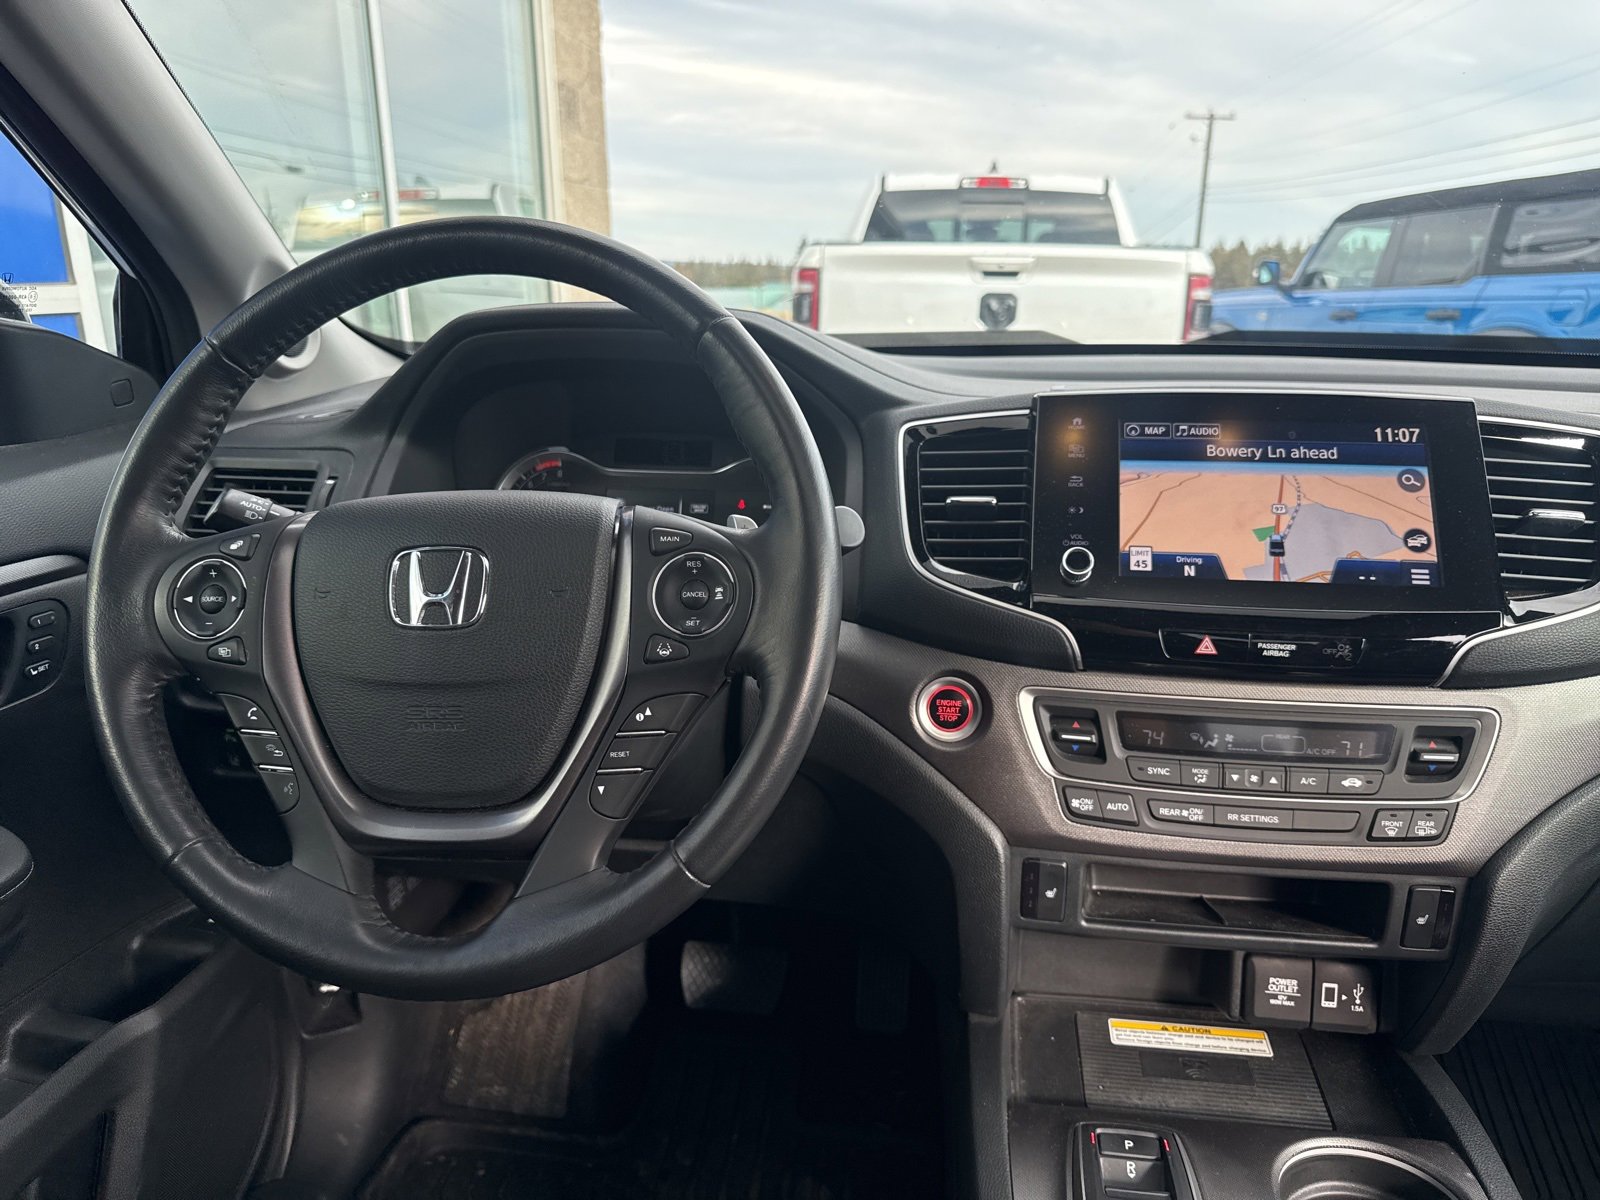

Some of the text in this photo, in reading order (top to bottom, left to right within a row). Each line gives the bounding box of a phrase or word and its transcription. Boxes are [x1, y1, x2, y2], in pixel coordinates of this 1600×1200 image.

[1145, 427, 1166, 435] MAP
[1189, 427, 1219, 436] AUDIO
[1374, 427, 1420, 443] 11:07
[1206, 444, 1338, 460] Bowery Ln ahead
[240, 500, 263, 511] AUTO
[1274, 505, 1284, 513] 97
[686, 560, 702, 568] RES
[1133, 559, 1148, 569] 45
[1176, 556, 1203, 565] Driving
[1183, 565, 1196, 577] N
[1257, 642, 1297, 651] PASSENGER
[1262, 649, 1290, 658] AIRBAG
[936, 699, 963, 707] ENGINE
[939, 714, 959, 722] STOP
[1142, 729, 1165, 746] 74
[1147, 766, 1171, 776] SYNC
[1300, 776, 1317, 786] A/C
[1106, 802, 1129, 811] AUTO
[1159, 807, 1181, 817] REAR
[1188, 814, 1204, 822] OFF
[1227, 813, 1280, 824] RR SETTINGS
[1381, 820, 1403, 828] FRONT
[1417, 820, 1435, 828] REAR
[1269, 977, 1299, 986] POWER
[1268, 984, 1299, 993] OUTLET
[1171, 1025, 1212, 1035] CAUTION
[1124, 1139, 1134, 1150] P
[1126, 1160, 1136, 1174] R
